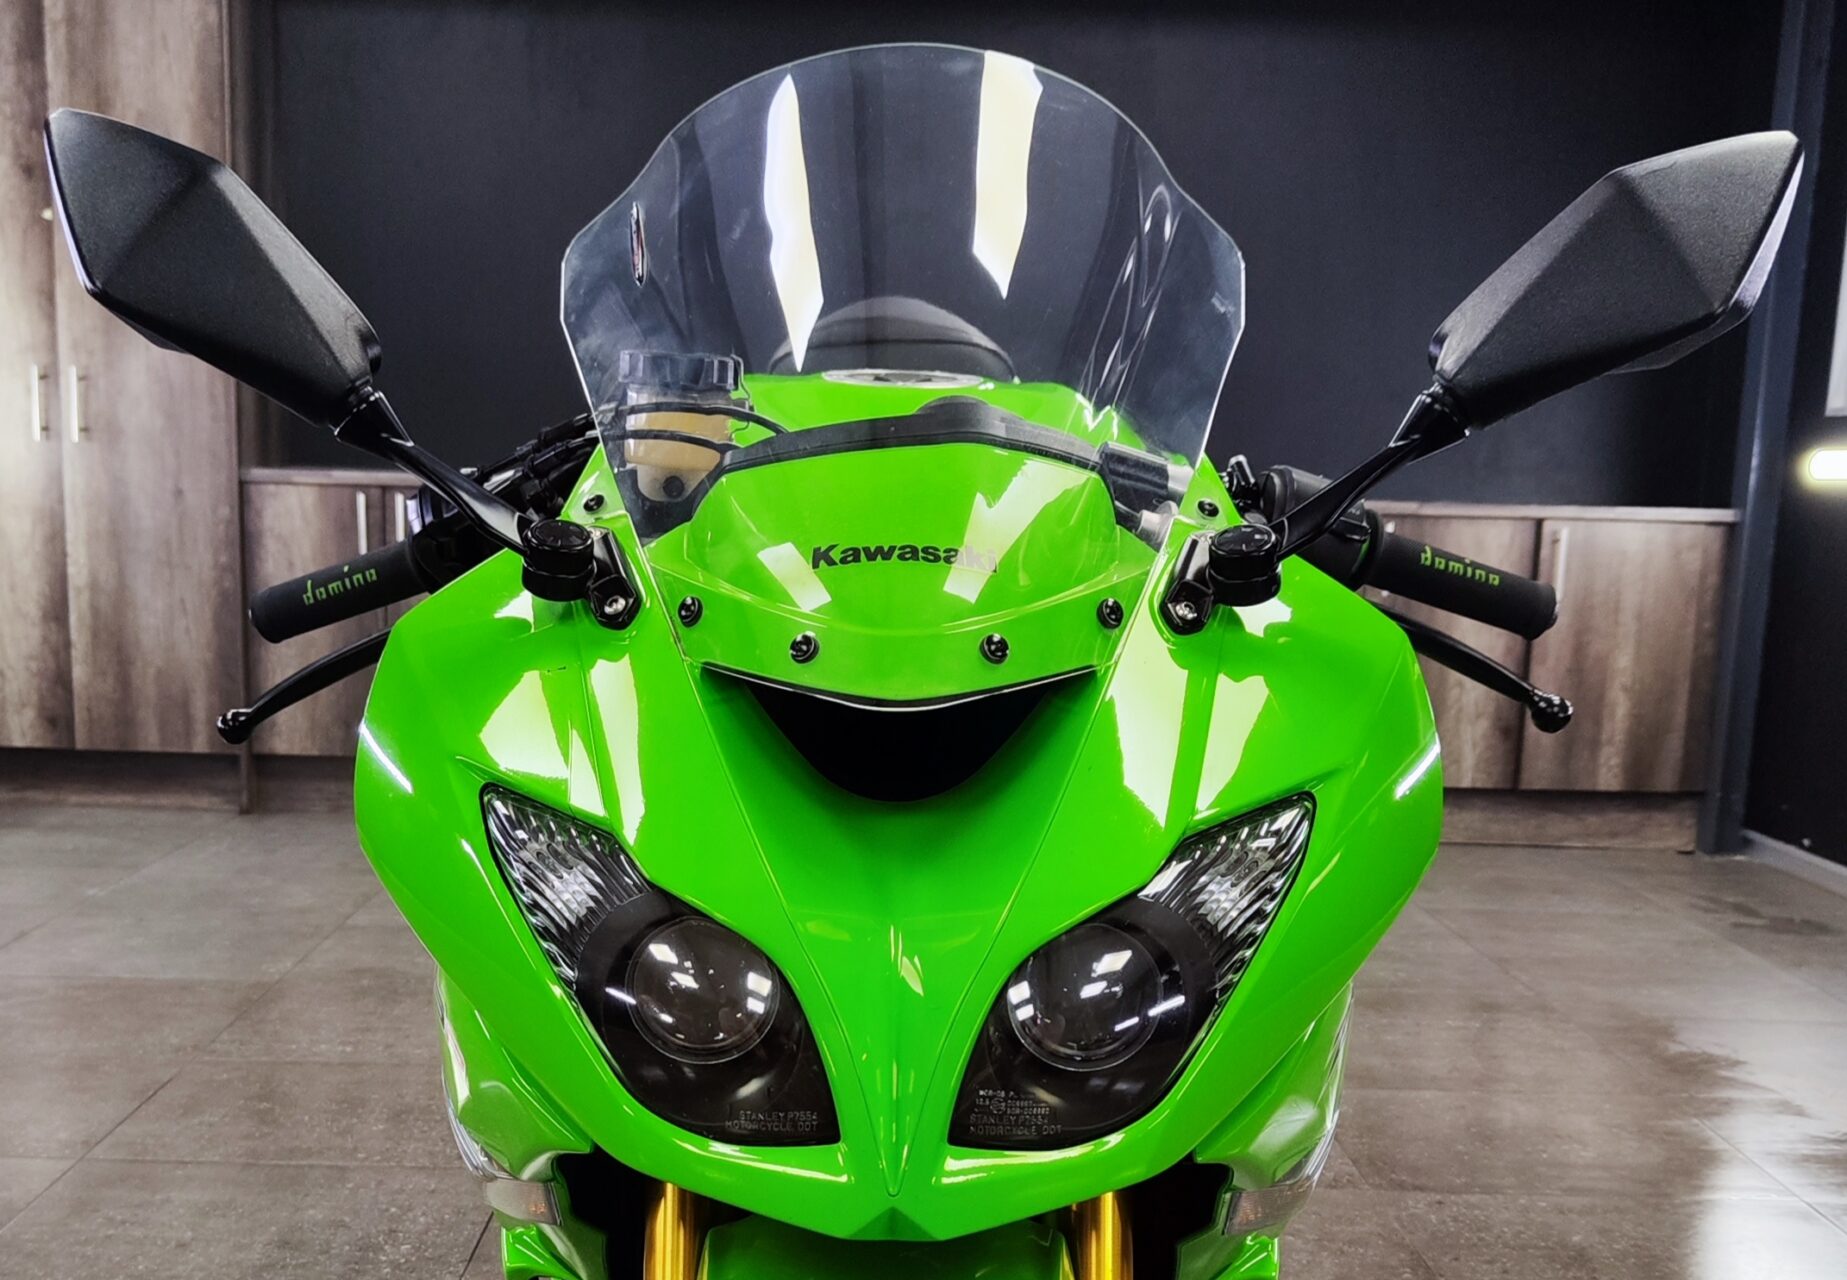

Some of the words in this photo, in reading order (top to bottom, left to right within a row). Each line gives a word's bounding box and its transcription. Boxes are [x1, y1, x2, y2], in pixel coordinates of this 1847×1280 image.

[1420, 545, 1500, 586] domino
[303, 565, 378, 606] domino
[739, 1110, 785, 1121] STANLEY
[970, 1113, 1016, 1125] STANLEY
[725, 1120, 793, 1132] MOTORCYCLE
[798, 1121, 818, 1132] DOT
[1042, 1125, 1062, 1136] DOT
